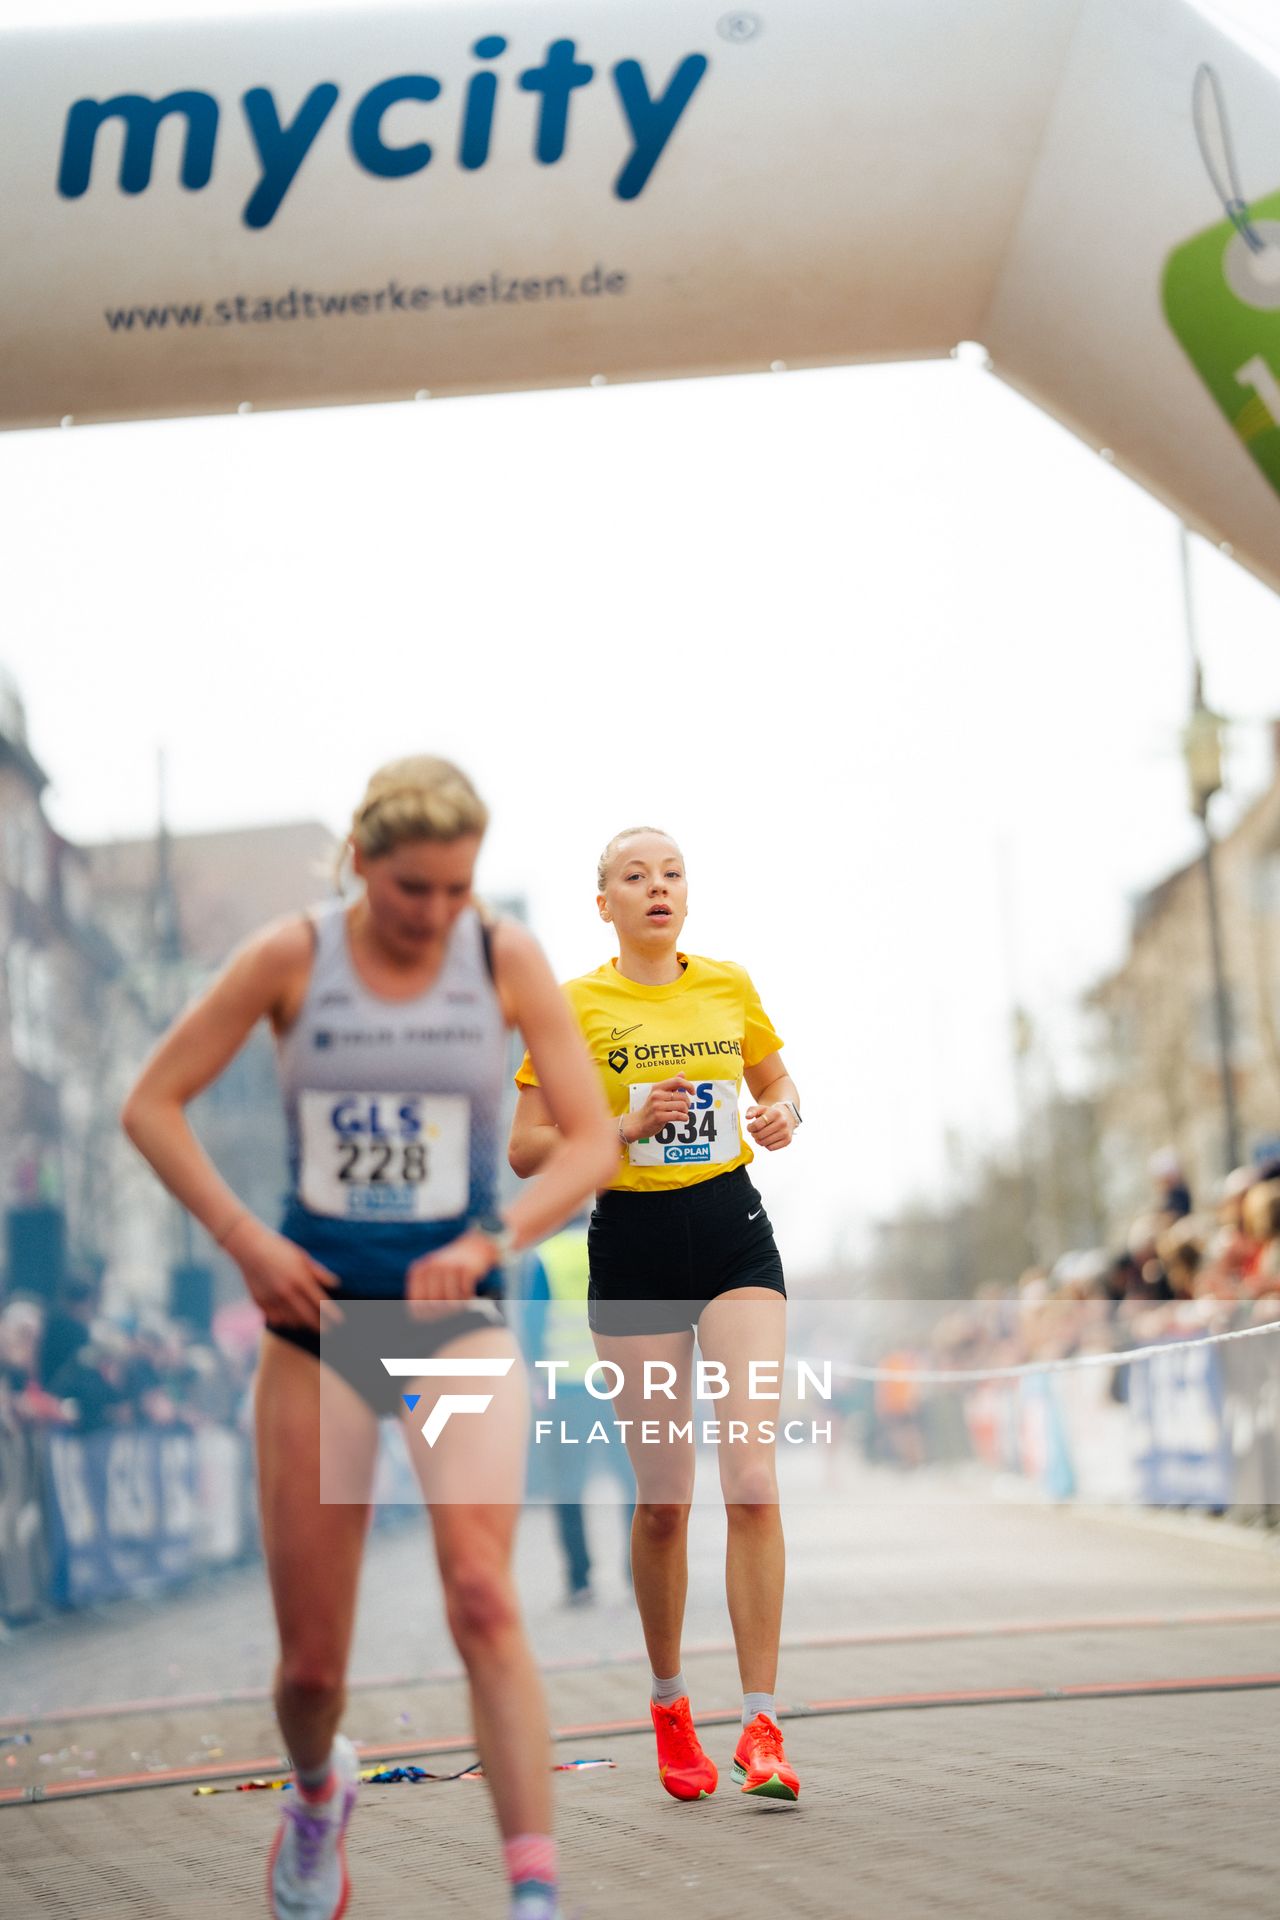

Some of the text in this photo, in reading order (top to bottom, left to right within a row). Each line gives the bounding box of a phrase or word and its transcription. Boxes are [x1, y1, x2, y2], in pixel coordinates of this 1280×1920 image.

[56, 34, 708, 229] mycity
[105, 264, 628, 332] www.stadtwerke-uelzen.de
[634, 1040, 741, 1061] ÖFFENTLICHE
[635, 1058, 687, 1069] OLDENBURG
[338, 1144, 427, 1182] 228
[684, 1146, 709, 1156] PLAN
